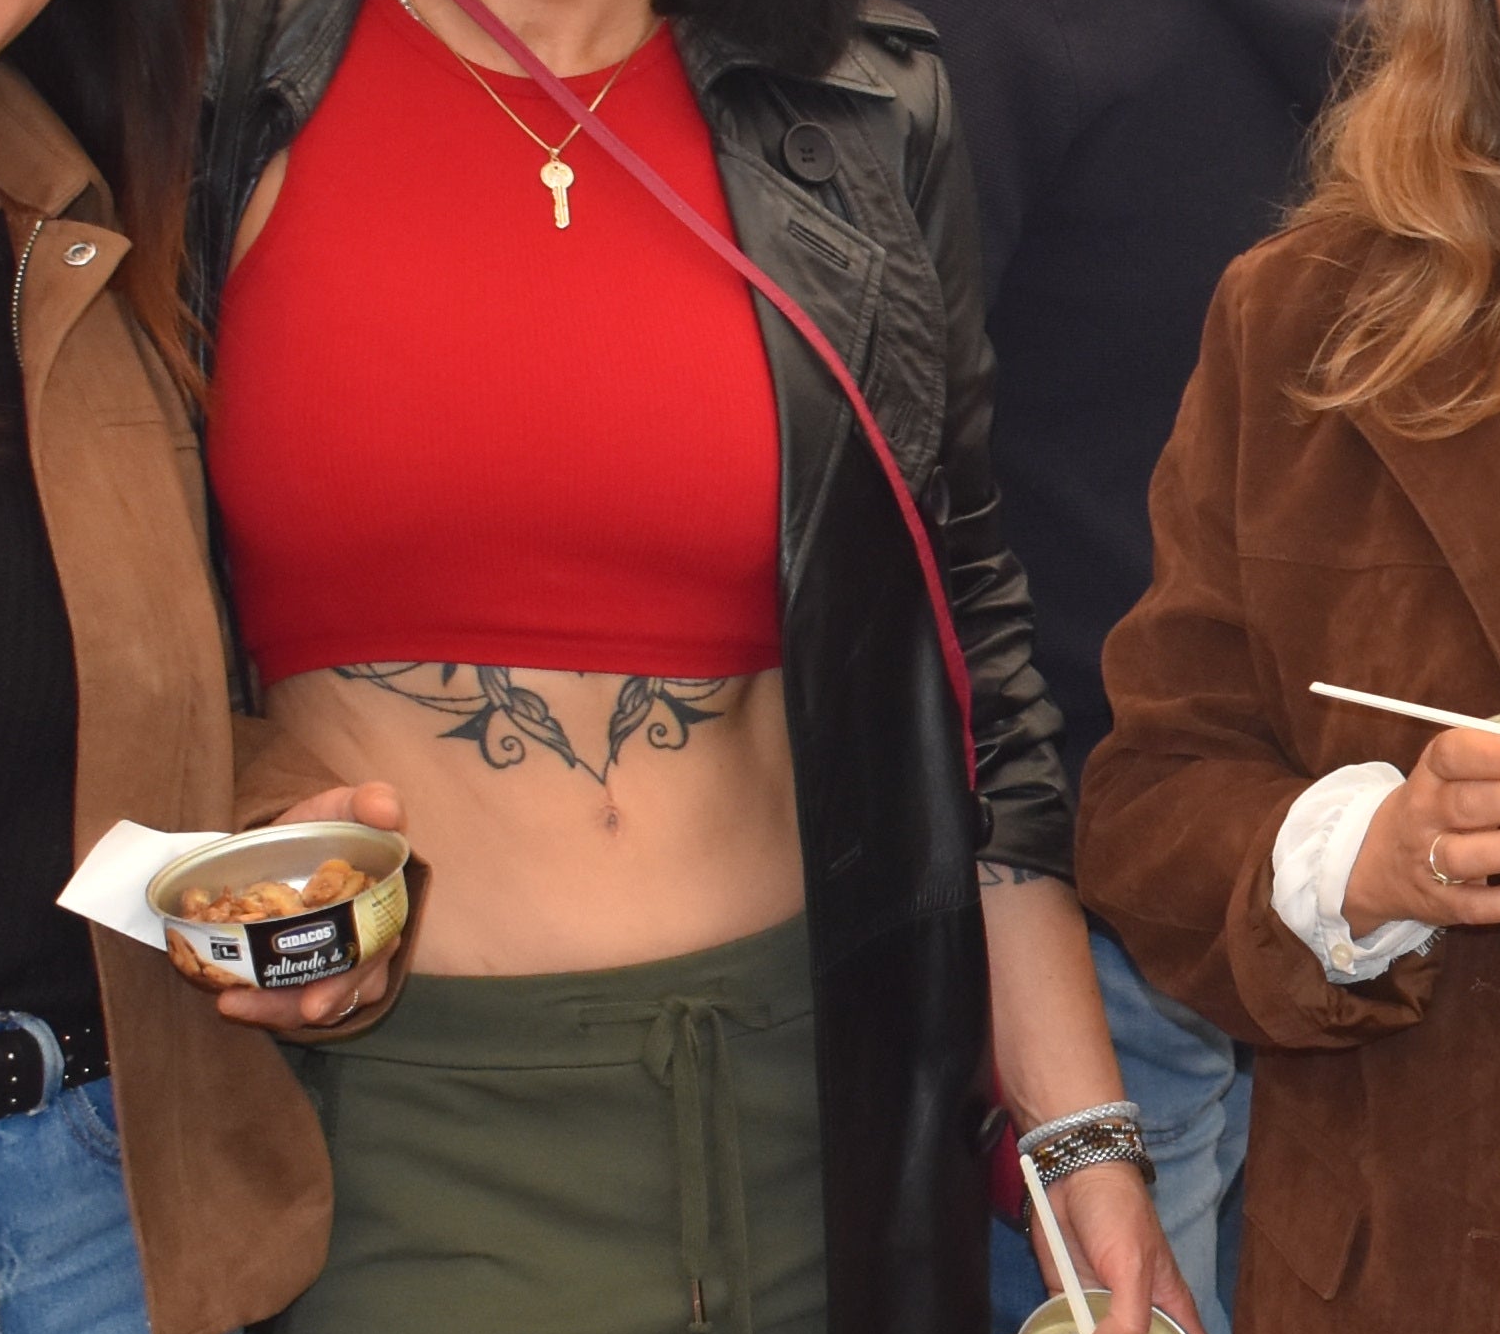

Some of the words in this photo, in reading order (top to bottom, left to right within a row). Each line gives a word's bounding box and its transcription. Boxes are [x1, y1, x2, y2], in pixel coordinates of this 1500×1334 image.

[277, 926, 332, 949] CIDACOS
[264, 951, 327, 977] salteado
[331, 948, 343, 963] de
